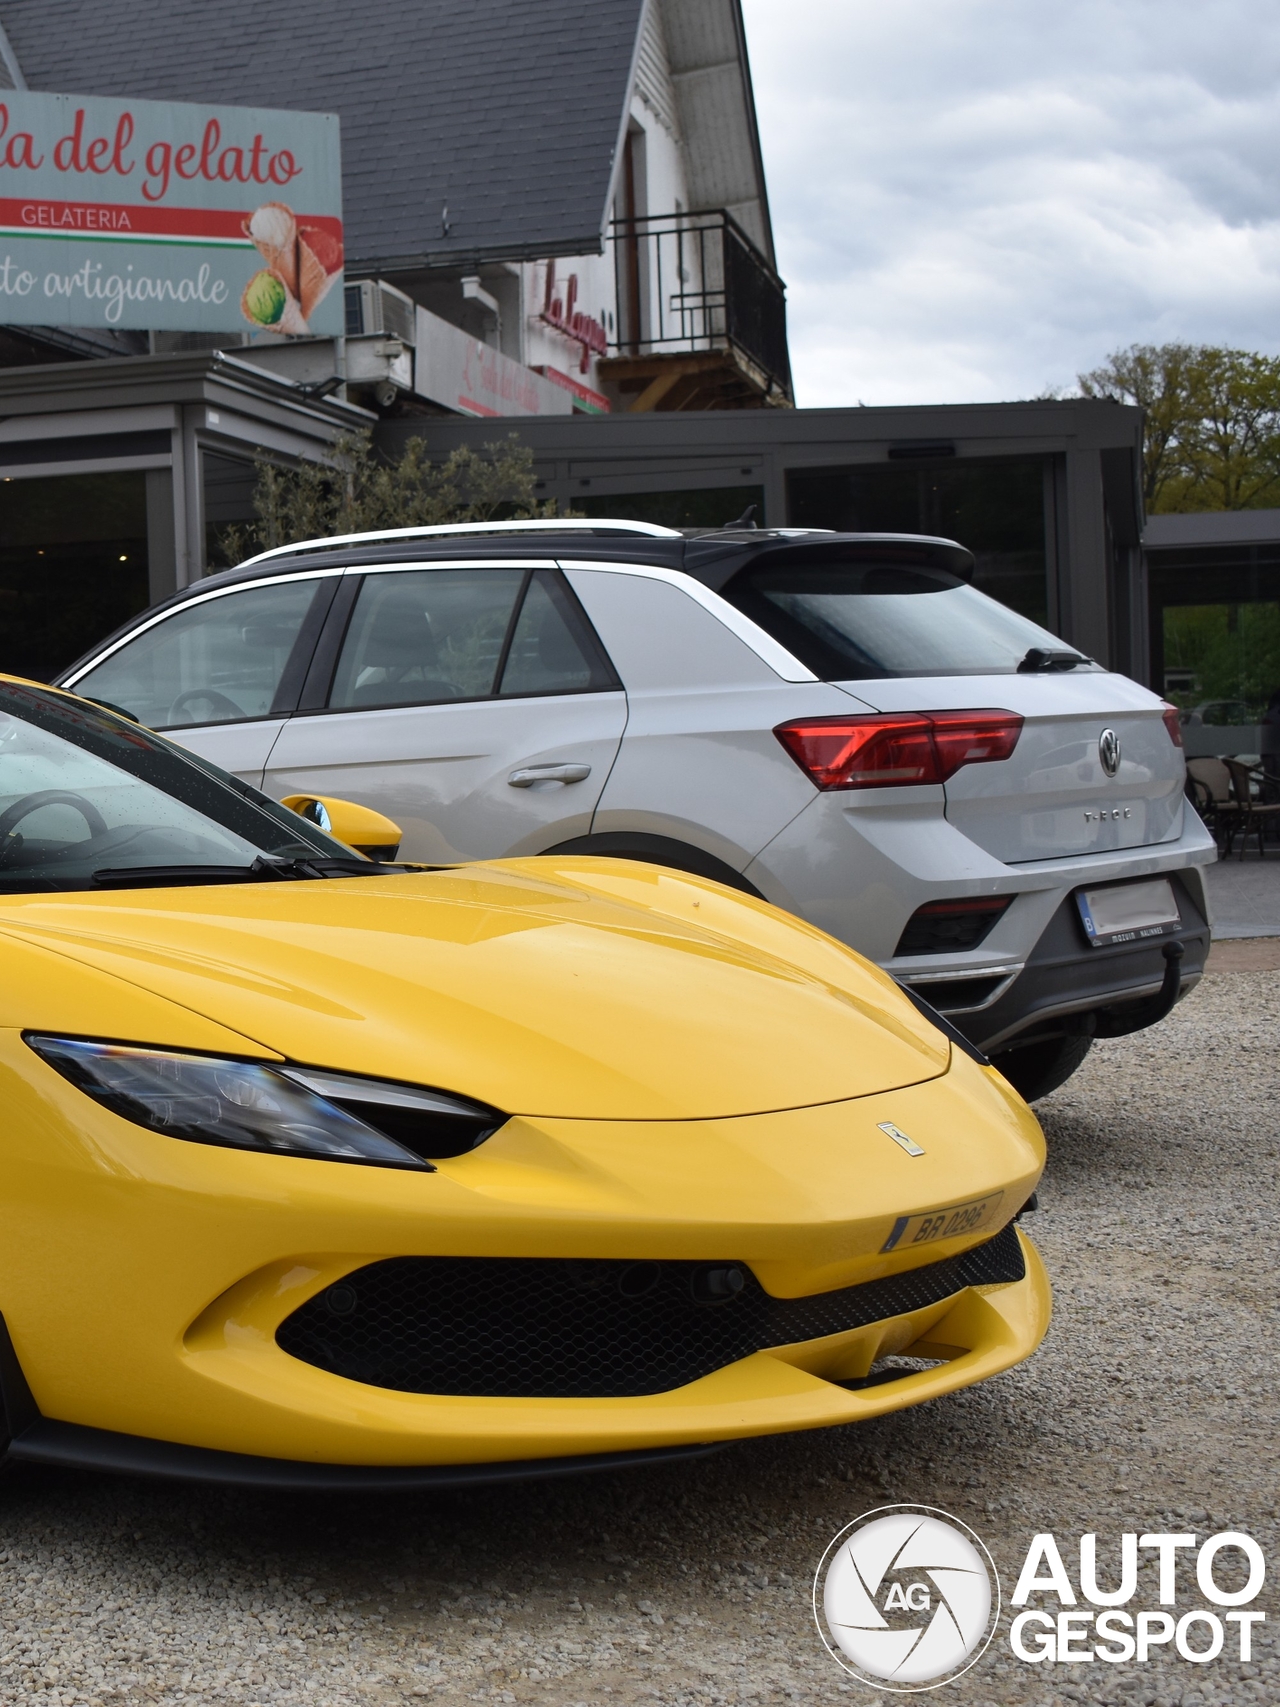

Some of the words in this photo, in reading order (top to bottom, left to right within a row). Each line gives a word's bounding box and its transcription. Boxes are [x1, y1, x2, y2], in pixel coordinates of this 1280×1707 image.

[53, 108, 135, 176] del
[141, 118, 303, 201] gelato
[21, 205, 132, 229] GELATERIA
[44, 259, 229, 323] artigianale
[1084, 917, 1094, 932] B
[912, 1215, 945, 1243] BR
